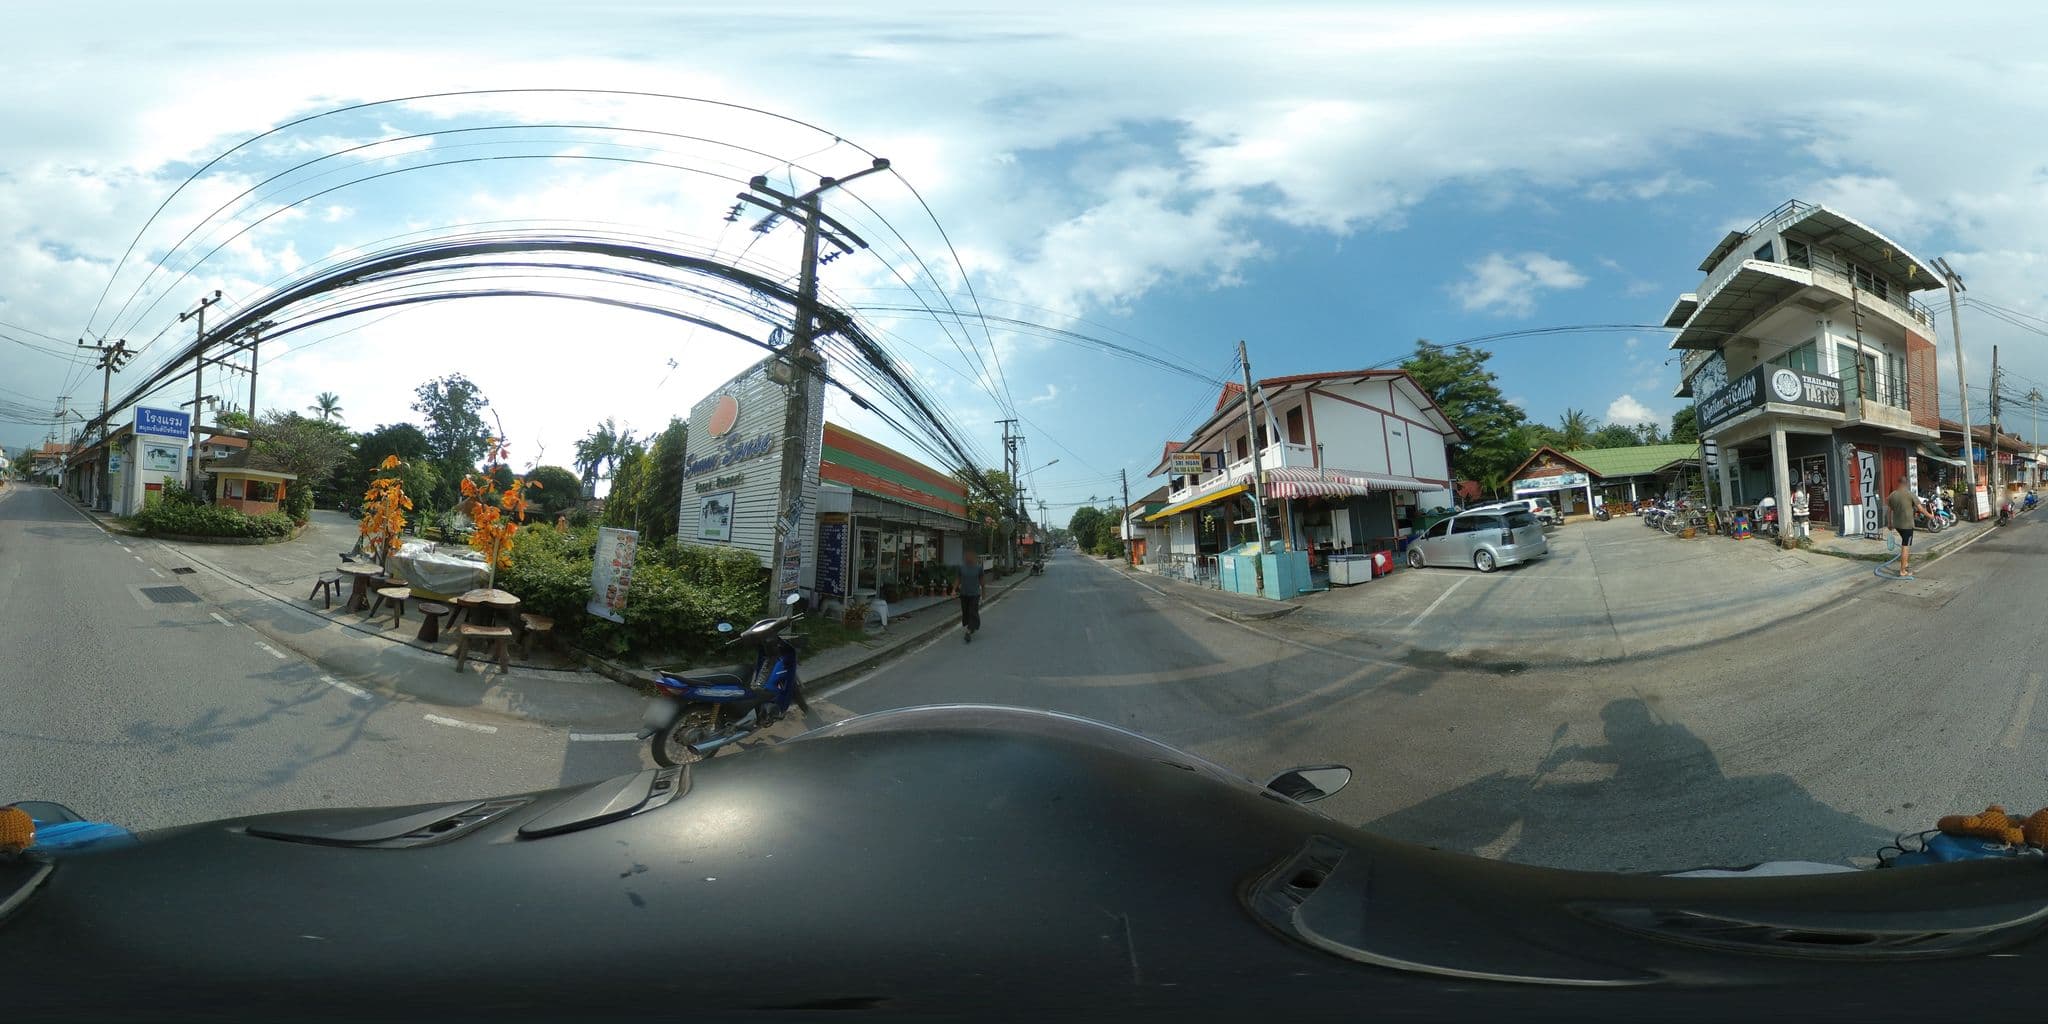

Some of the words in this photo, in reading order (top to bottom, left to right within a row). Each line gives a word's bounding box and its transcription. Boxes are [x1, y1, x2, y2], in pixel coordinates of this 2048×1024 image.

[144, 410, 182, 427] โรงแรม
[1860, 456, 1877, 531] TATTOO
